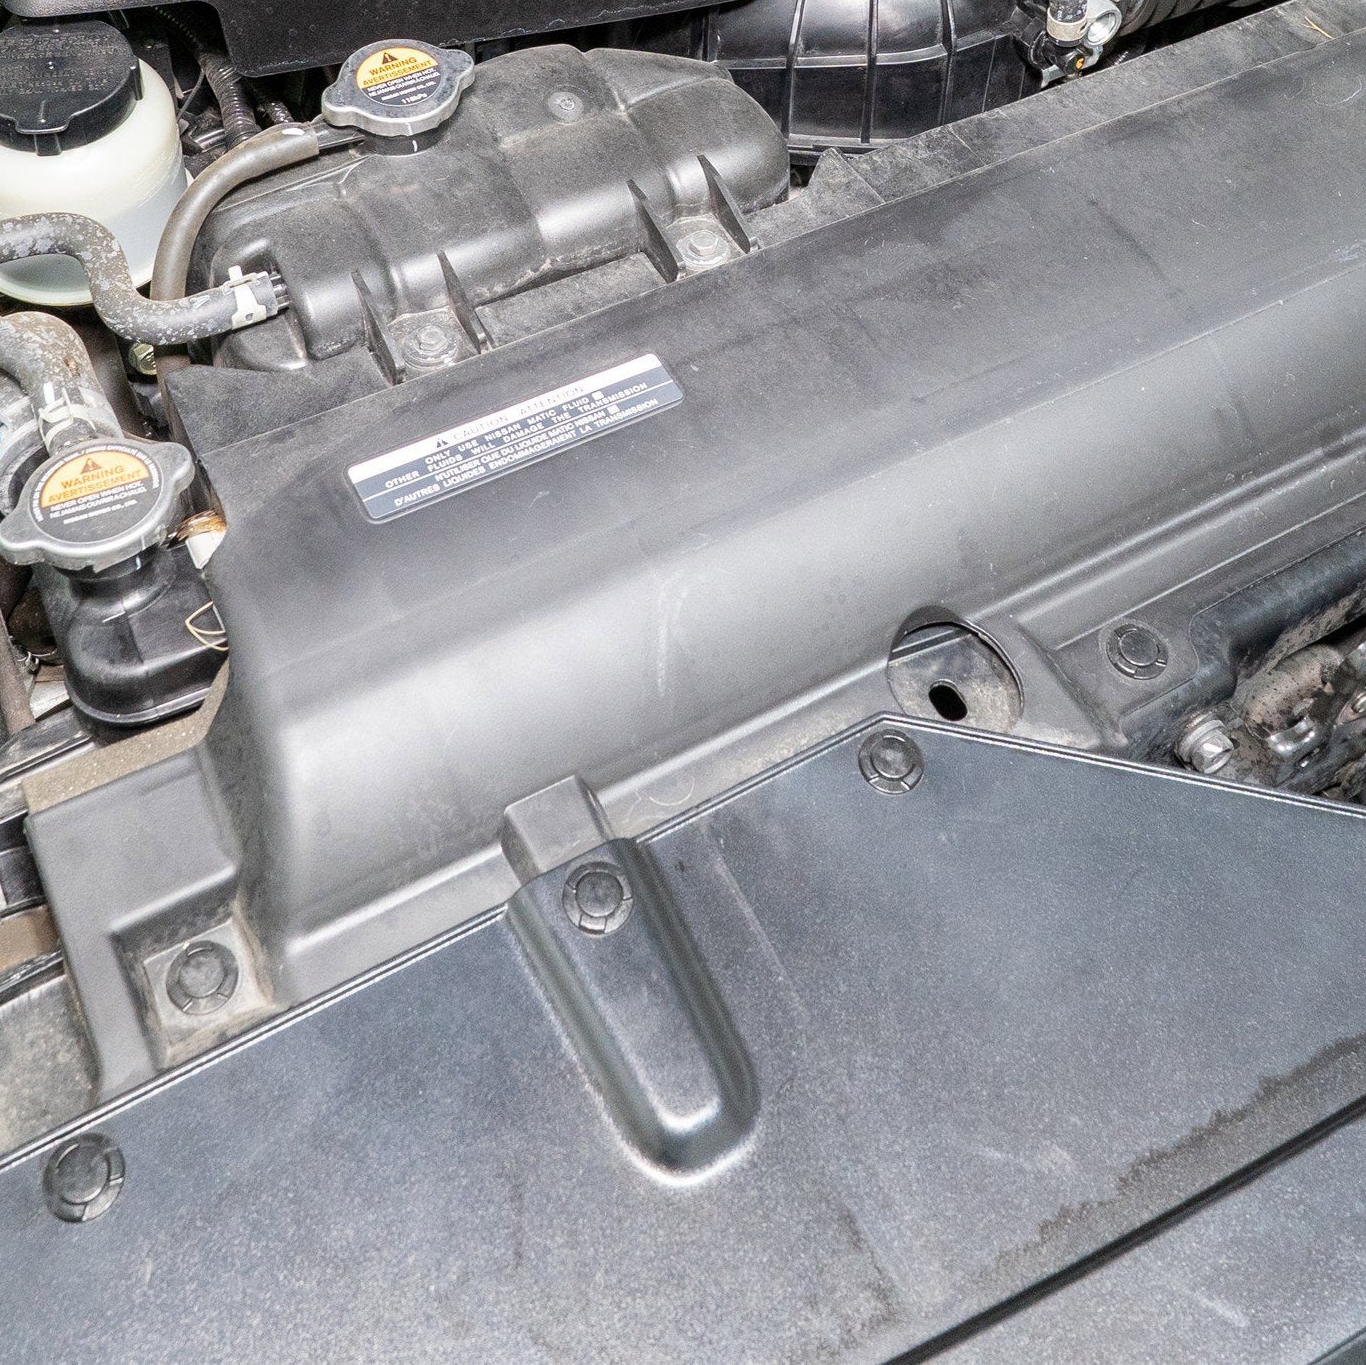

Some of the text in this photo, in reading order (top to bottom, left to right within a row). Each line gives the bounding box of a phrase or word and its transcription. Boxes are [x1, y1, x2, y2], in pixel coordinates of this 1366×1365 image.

[364, 61, 430, 84] AVERTISSEMENT
[370, 57, 415, 74] WARNING
[384, 469, 420, 489] OTHER
[426, 452, 463, 472] FLUIDS
[470, 440, 495, 455] WILL
[502, 421, 545, 443] DAMAGE
[550, 410, 571, 424] THE
[577, 381, 648, 413] TRANSMISSION
[424, 448, 451, 464] ONLY
[457, 438, 479, 451] USE
[484, 422, 521, 441] NISSAN
[526, 408, 556, 425] MATIC
[561, 395, 589, 412] FLUID
[452, 414, 509, 441] CAUTION
[480, 450, 500, 463] QUE
[499, 444, 514, 455] DU
[513, 431, 549, 450] LIQUIDE
[547, 421, 574, 437] MATIC
[573, 409, 606, 427] NISSAN
[393, 483, 441, 507] D'AUTRES
[442, 465, 486, 487] LIQUIDES
[487, 429, 578, 469] ENDOMMAGERAIENT
[578, 423, 592, 433] LA
[593, 397, 659, 428] TRANSMISSION
[48, 470, 141, 501] AVERTISSEMENT
[62, 466, 123, 488] WARNING
[49, 499, 76, 511] NEVER
[78, 493, 99, 503] OPEN
